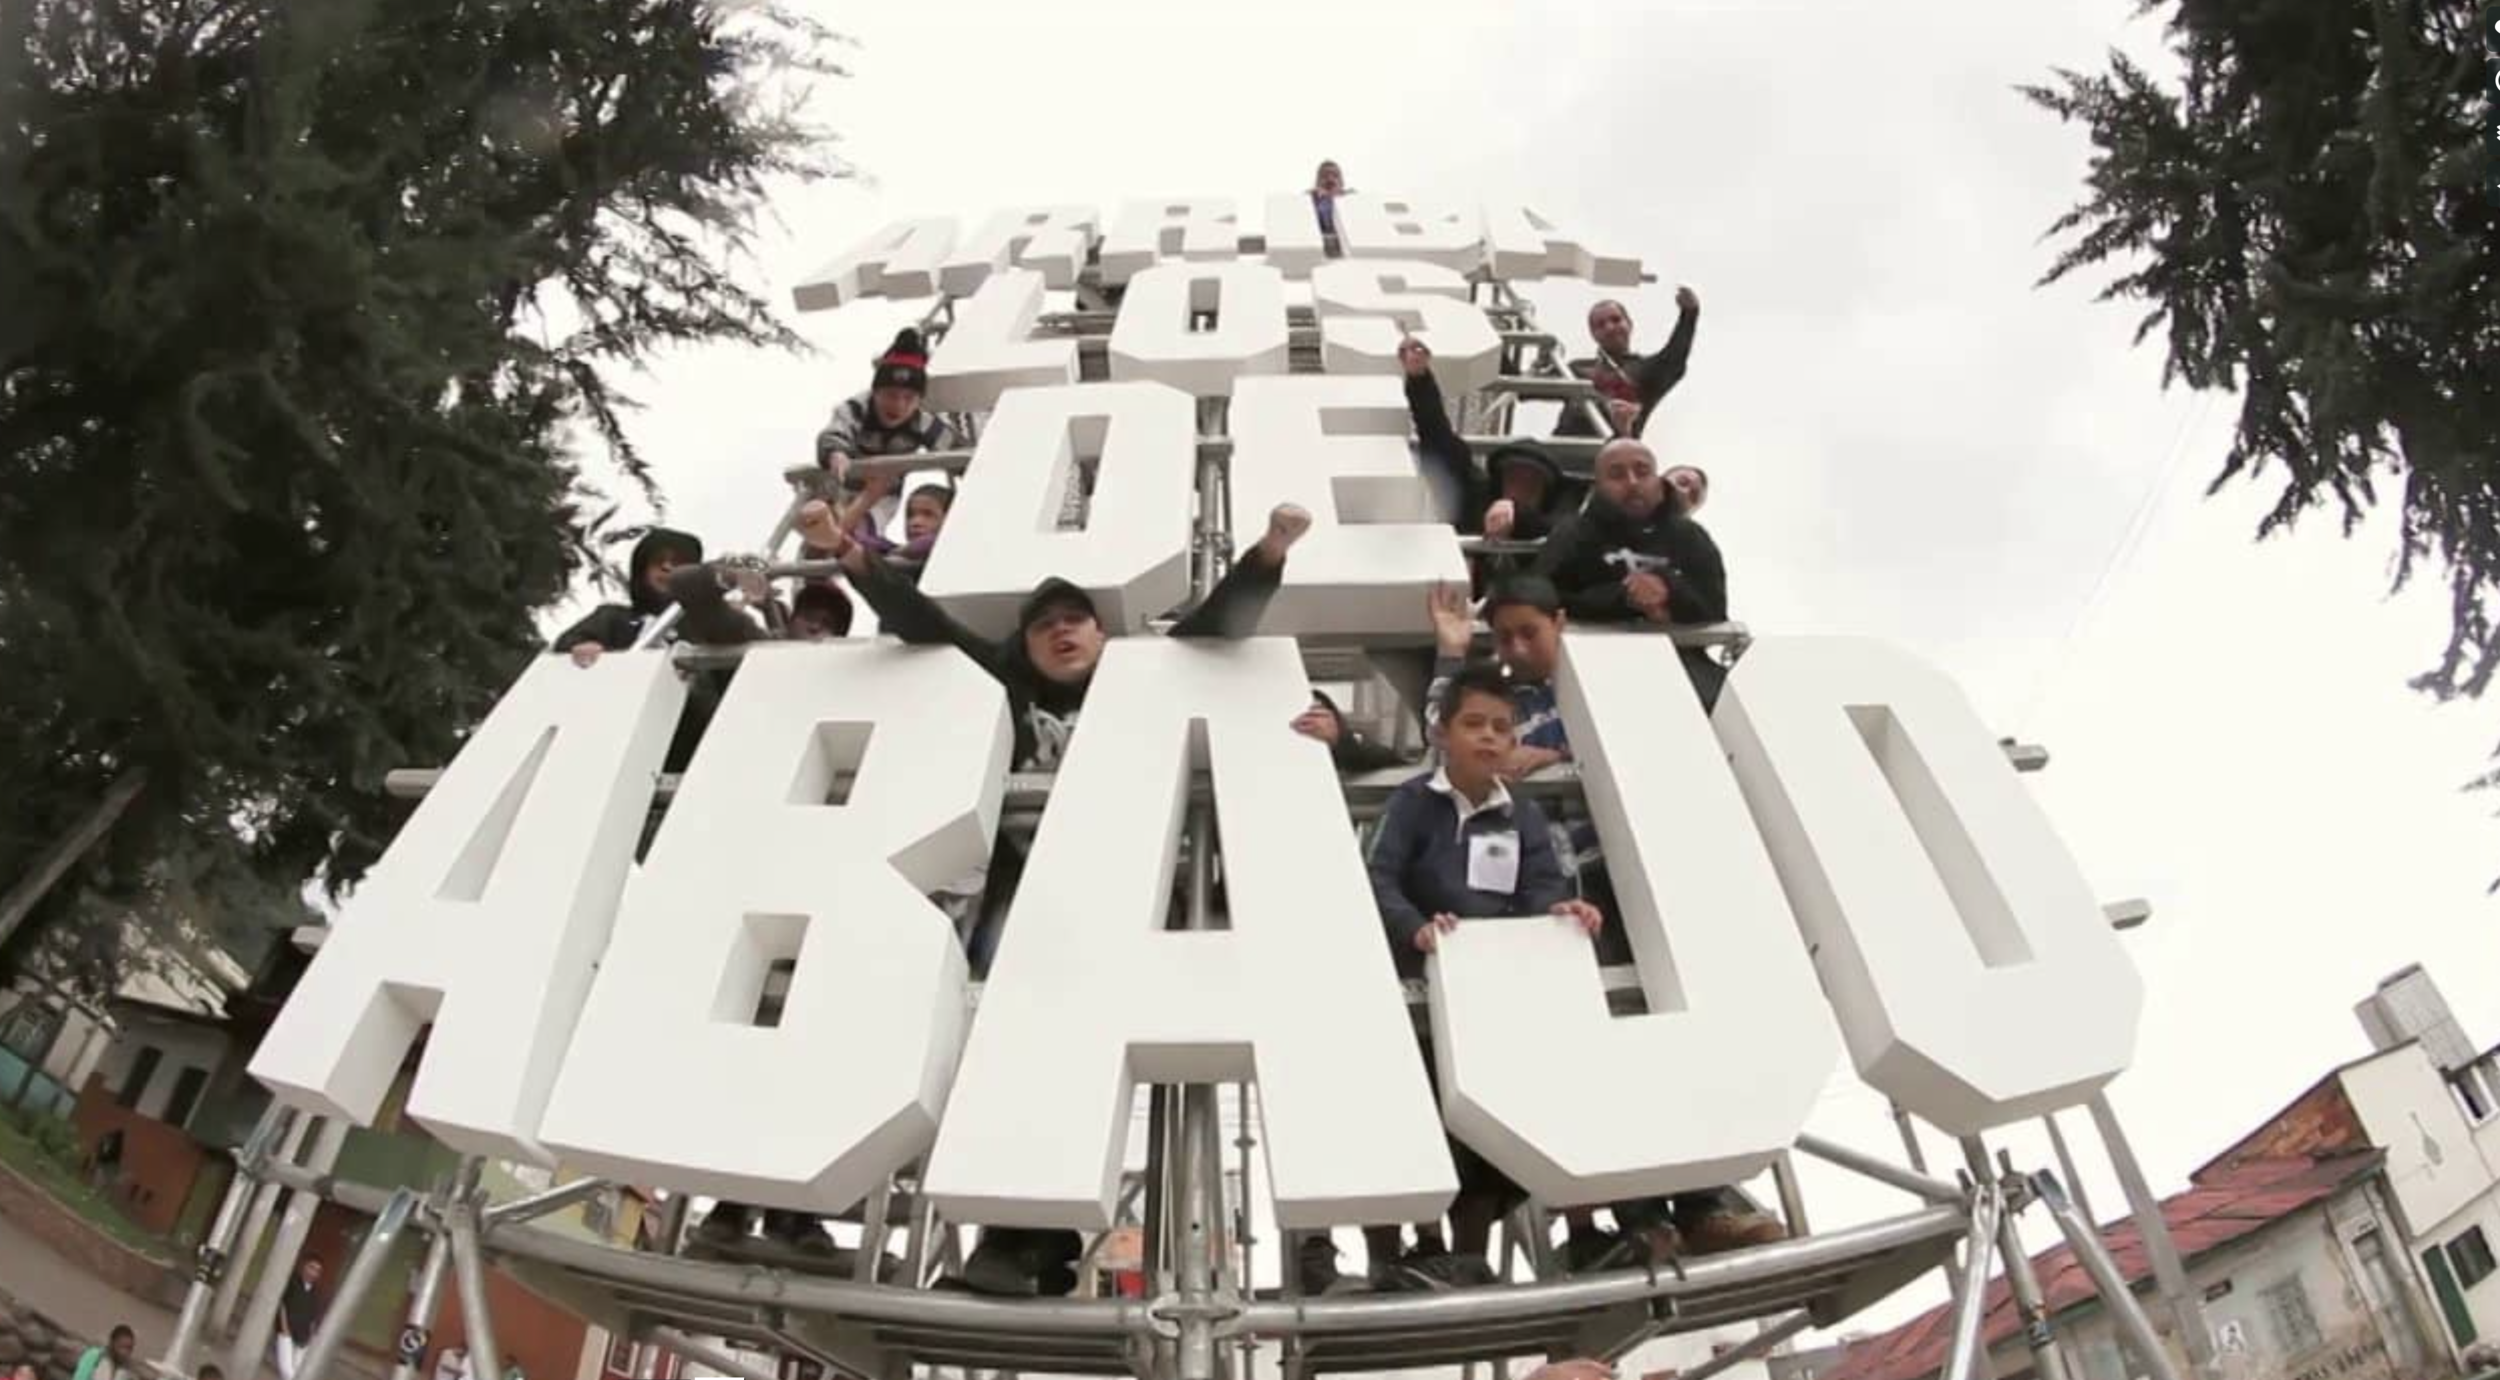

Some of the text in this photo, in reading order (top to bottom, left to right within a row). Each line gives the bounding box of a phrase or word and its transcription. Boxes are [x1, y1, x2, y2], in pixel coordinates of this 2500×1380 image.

[792, 196, 1642, 311] ARRIBA
[926, 260, 1502, 402] LOS
[918, 374, 1470, 638] DE
[250, 634, 2144, 1230] ABAJO
